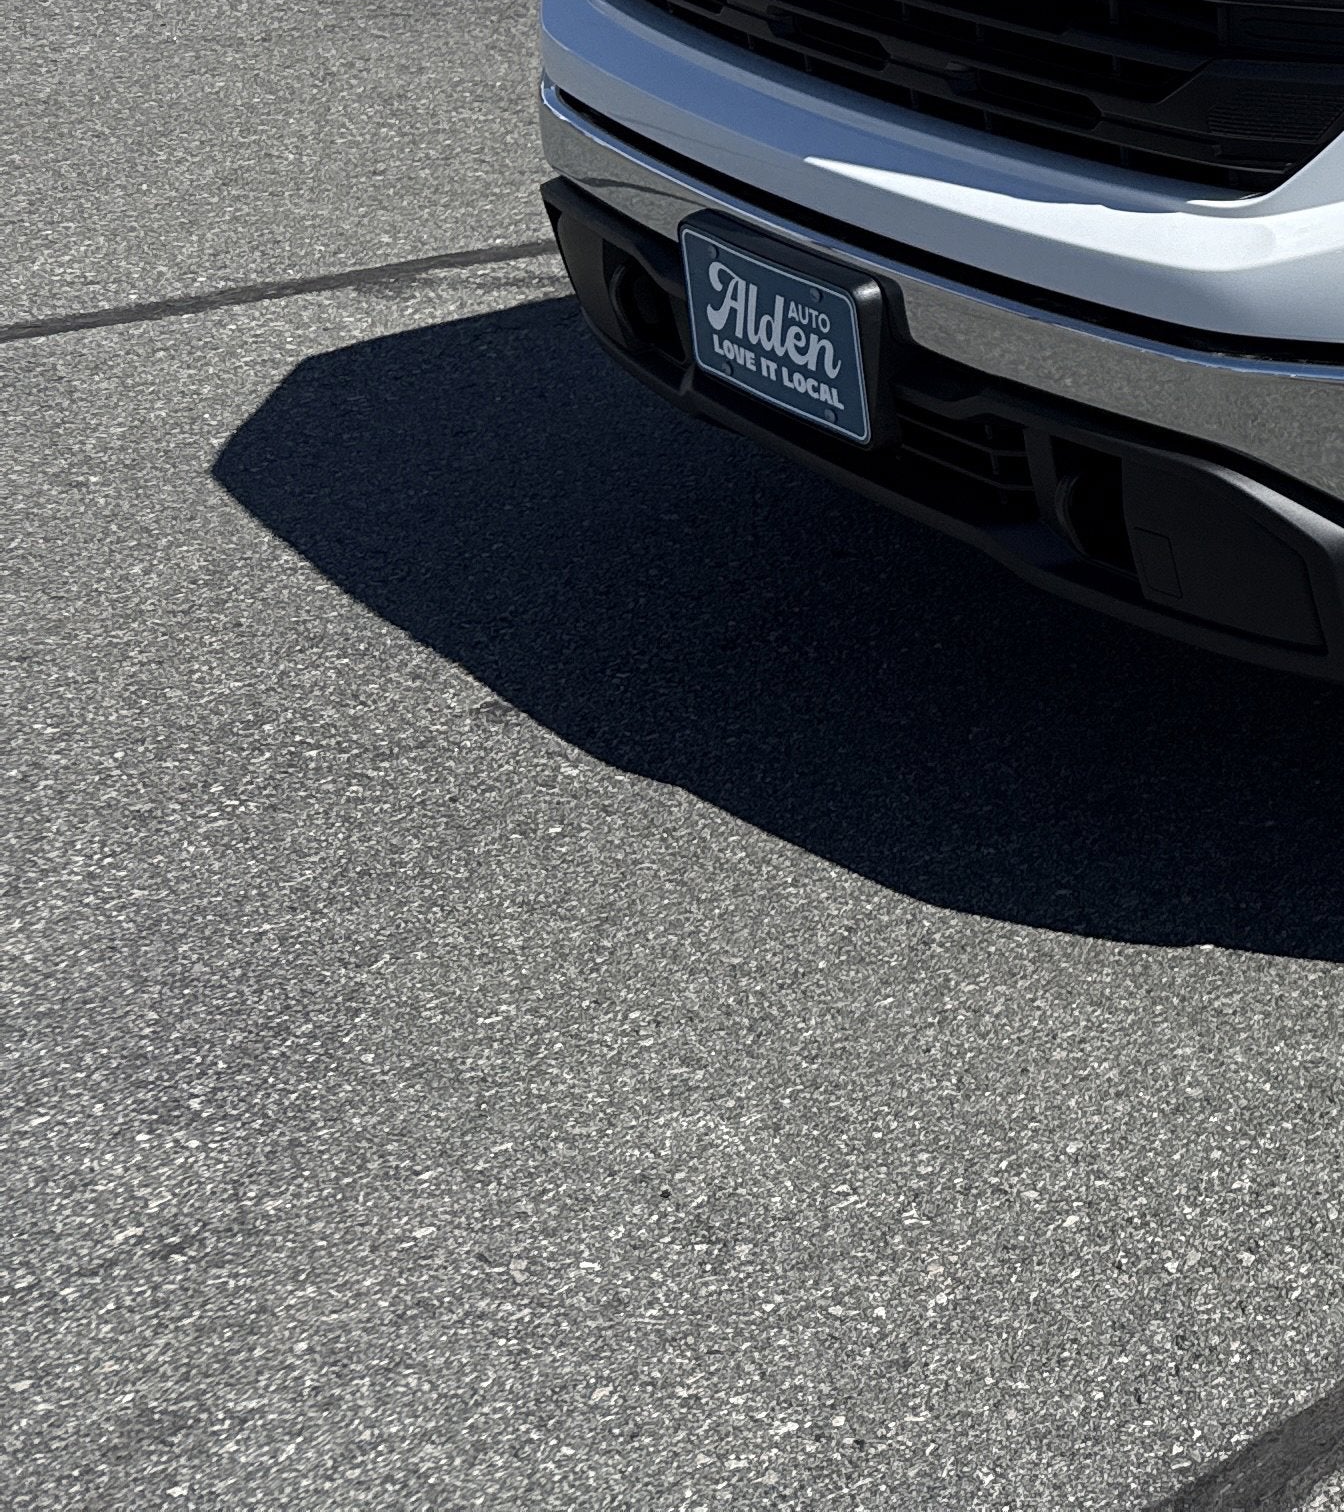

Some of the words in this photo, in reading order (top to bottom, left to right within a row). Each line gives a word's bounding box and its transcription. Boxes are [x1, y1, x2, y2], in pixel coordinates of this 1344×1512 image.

[706, 261, 842, 379] Alden
[787, 300, 831, 334] AUTO
[712, 333, 757, 373] LOVE
[760, 355, 778, 382] IT
[781, 366, 845, 411] LOCAL
